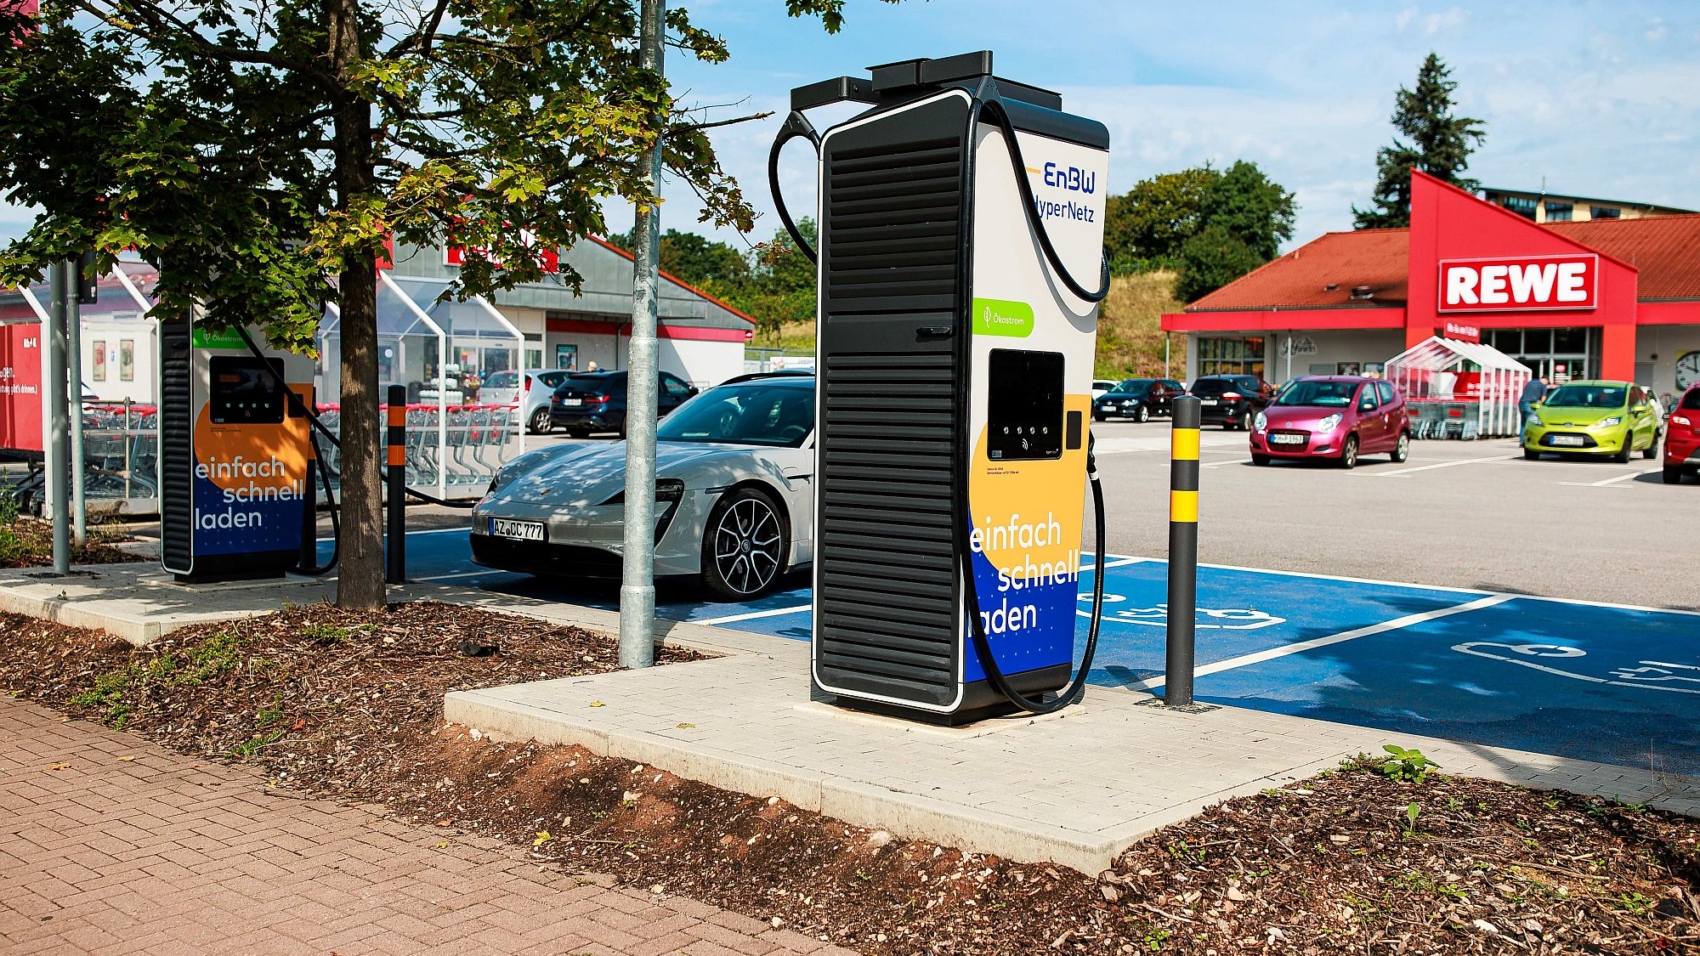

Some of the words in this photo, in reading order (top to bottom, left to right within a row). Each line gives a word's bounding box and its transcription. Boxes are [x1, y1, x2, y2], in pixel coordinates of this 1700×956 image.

[1044, 161, 1096, 195] EnBW
[1446, 262, 1588, 305] REWE
[993, 312, 1025, 325] Ökostrom
[195, 454, 285, 479] einfach
[223, 479, 304, 503] schnell
[195, 506, 262, 530] laden
[494, 520, 505, 535] AZ
[510, 522, 522, 536] CC
[524, 524, 542, 538] 777
[969, 511, 1061, 553] einfach
[997, 548, 1079, 592] schnell
